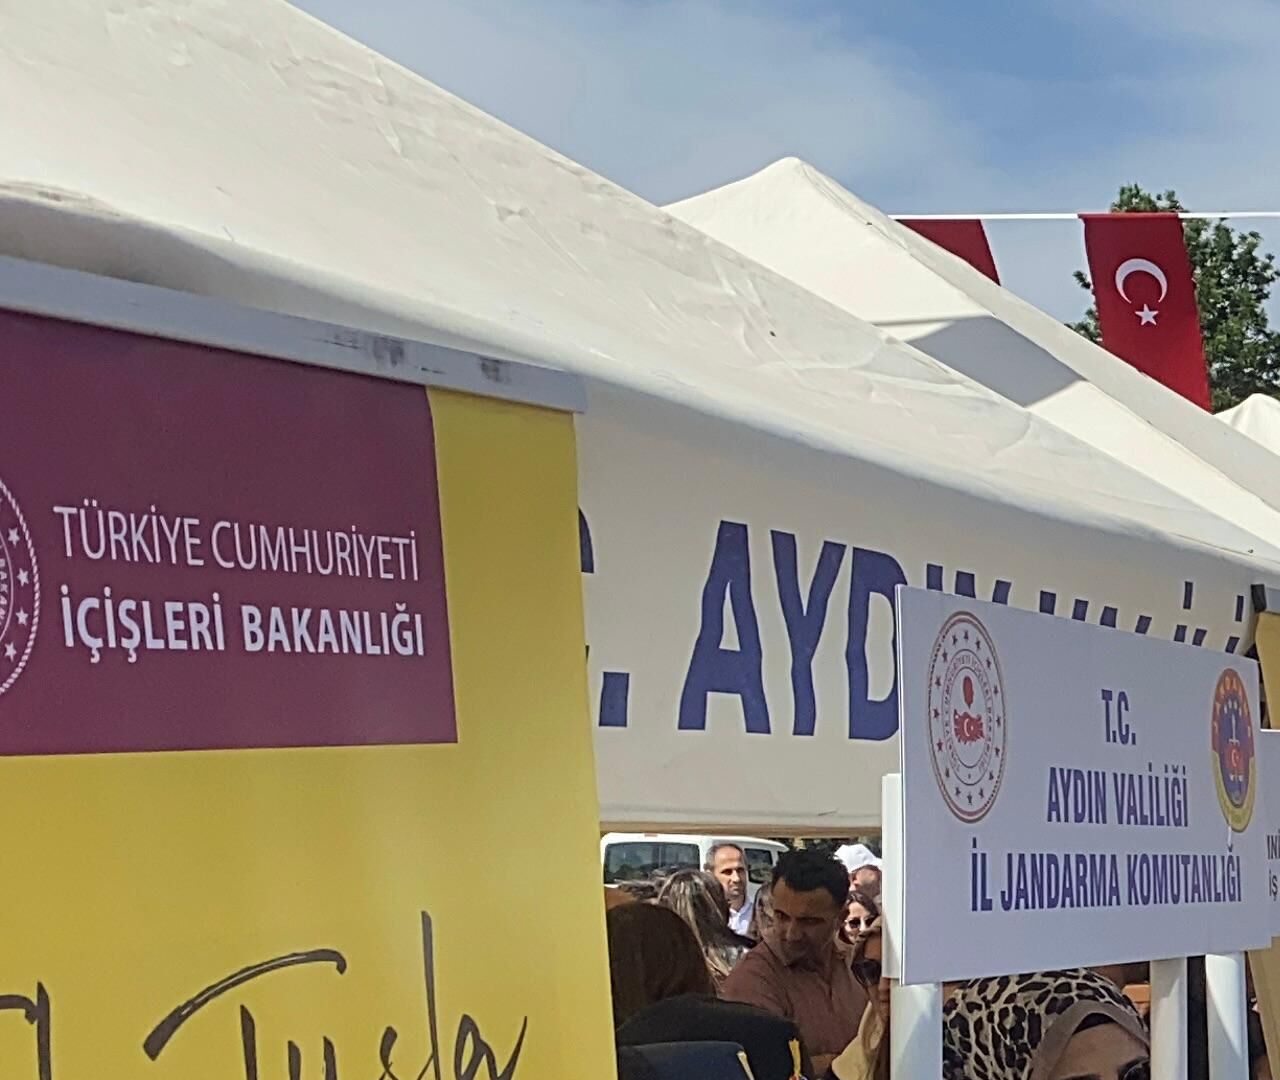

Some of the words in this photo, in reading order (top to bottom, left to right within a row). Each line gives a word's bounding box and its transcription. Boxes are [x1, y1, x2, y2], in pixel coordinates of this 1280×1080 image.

[53, 499, 204, 567] TÜRKİYE
[211, 519, 420, 582] CUMHURİYETİ
[61, 584, 226, 663] İÇİŞLERİ
[242, 602, 425, 657] BAKANLIĞI
[679, 520, 1011, 741] AYD
[1101, 688, 1136, 746] T.C.
[1047, 766, 1107, 824] AYDIN
[1113, 762, 1189, 828] VALİLİĞİ
[971, 837, 993, 912] İL
[1000, 852, 1121, 911] JANDARMA
[1127, 843, 1242, 906] KOMUTANLIĞI
